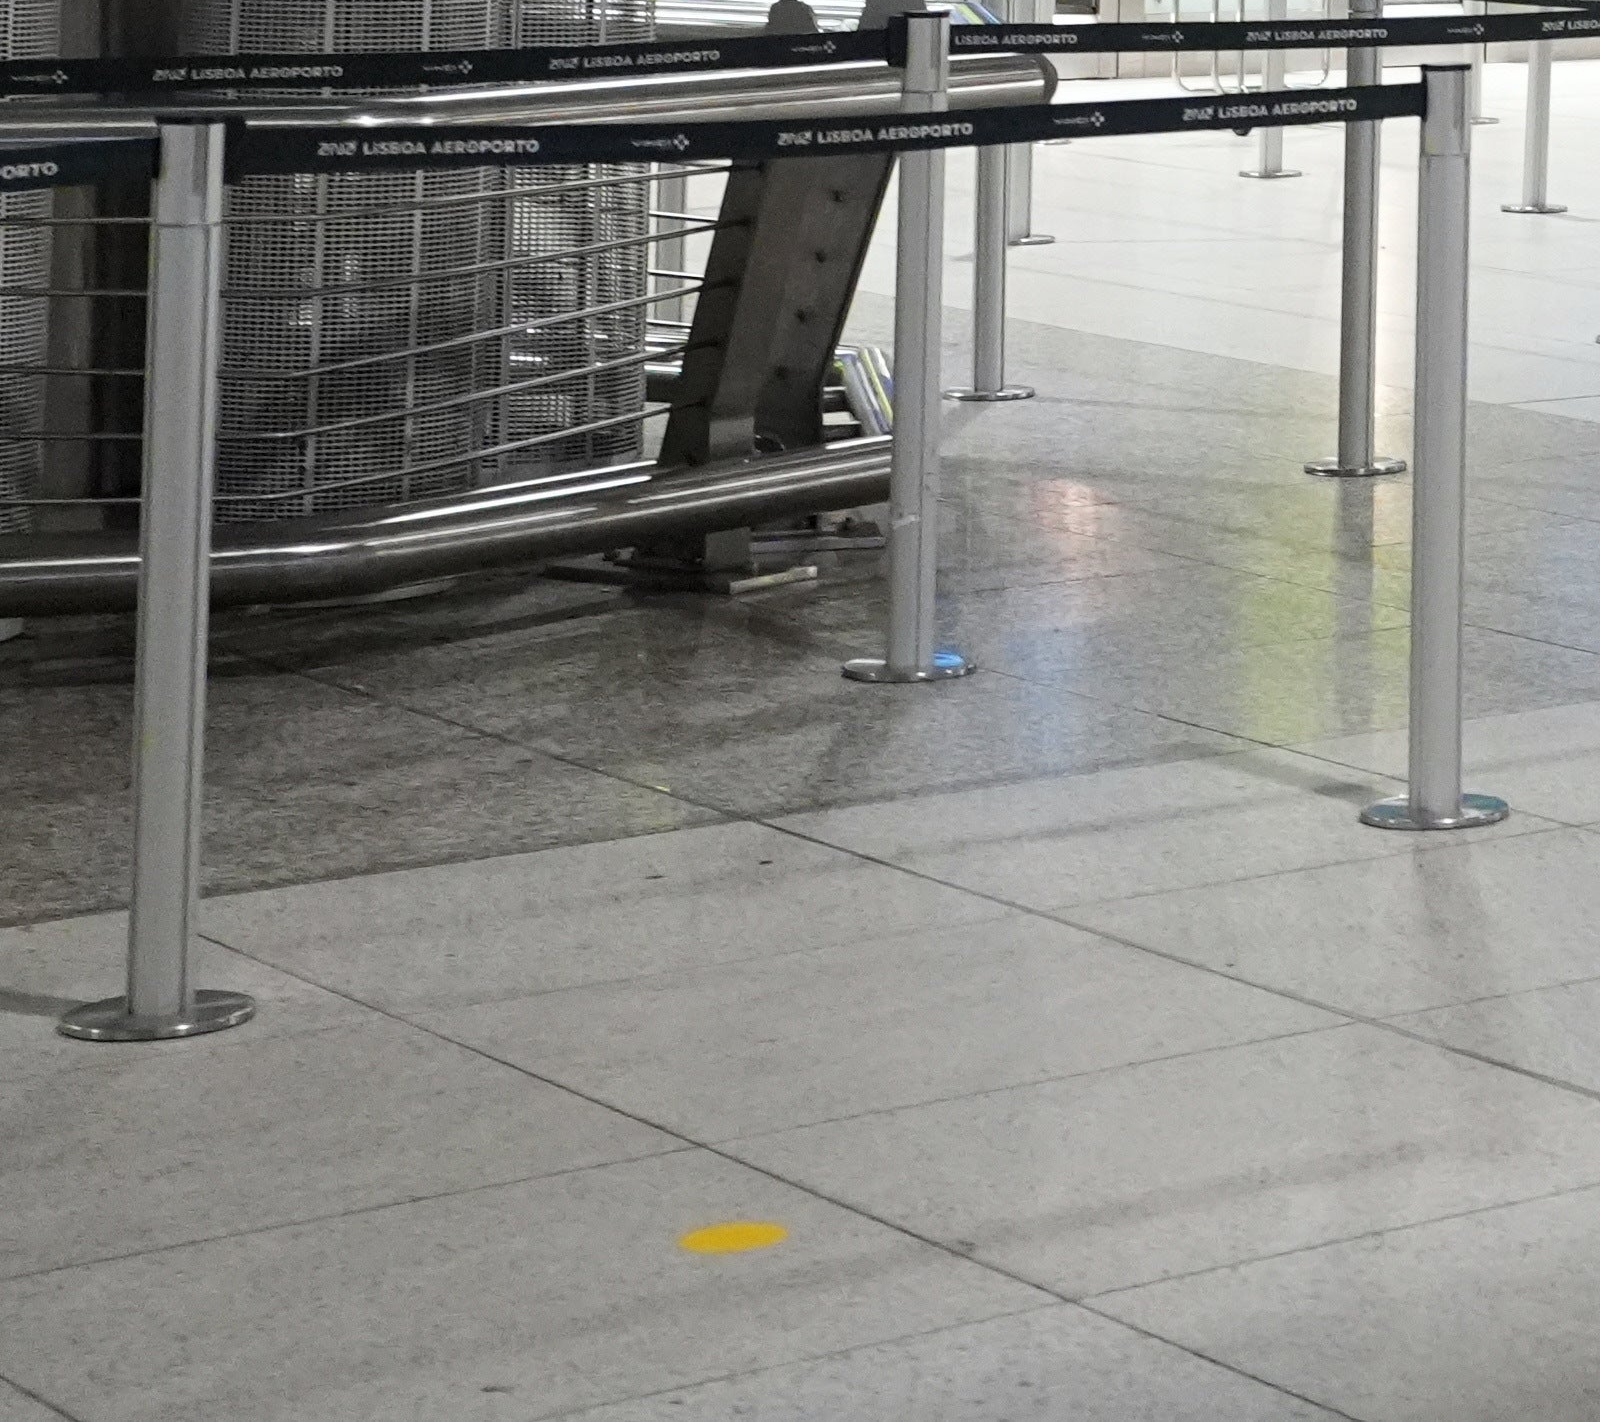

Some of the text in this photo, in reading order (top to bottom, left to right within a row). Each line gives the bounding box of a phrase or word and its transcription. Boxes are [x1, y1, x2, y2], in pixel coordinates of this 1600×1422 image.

[954, 33, 1078, 46] LISBOA AEROPORTO
[1217, 104, 1269, 119] LISBOA
[1271, 98, 1358, 116] AEROPORTO
[816, 128, 874, 144] LISBOA
[877, 122, 974, 140] AEROPORTO
[362, 141, 427, 156] LISBOA
[430, 139, 540, 154] AEROPORTO
